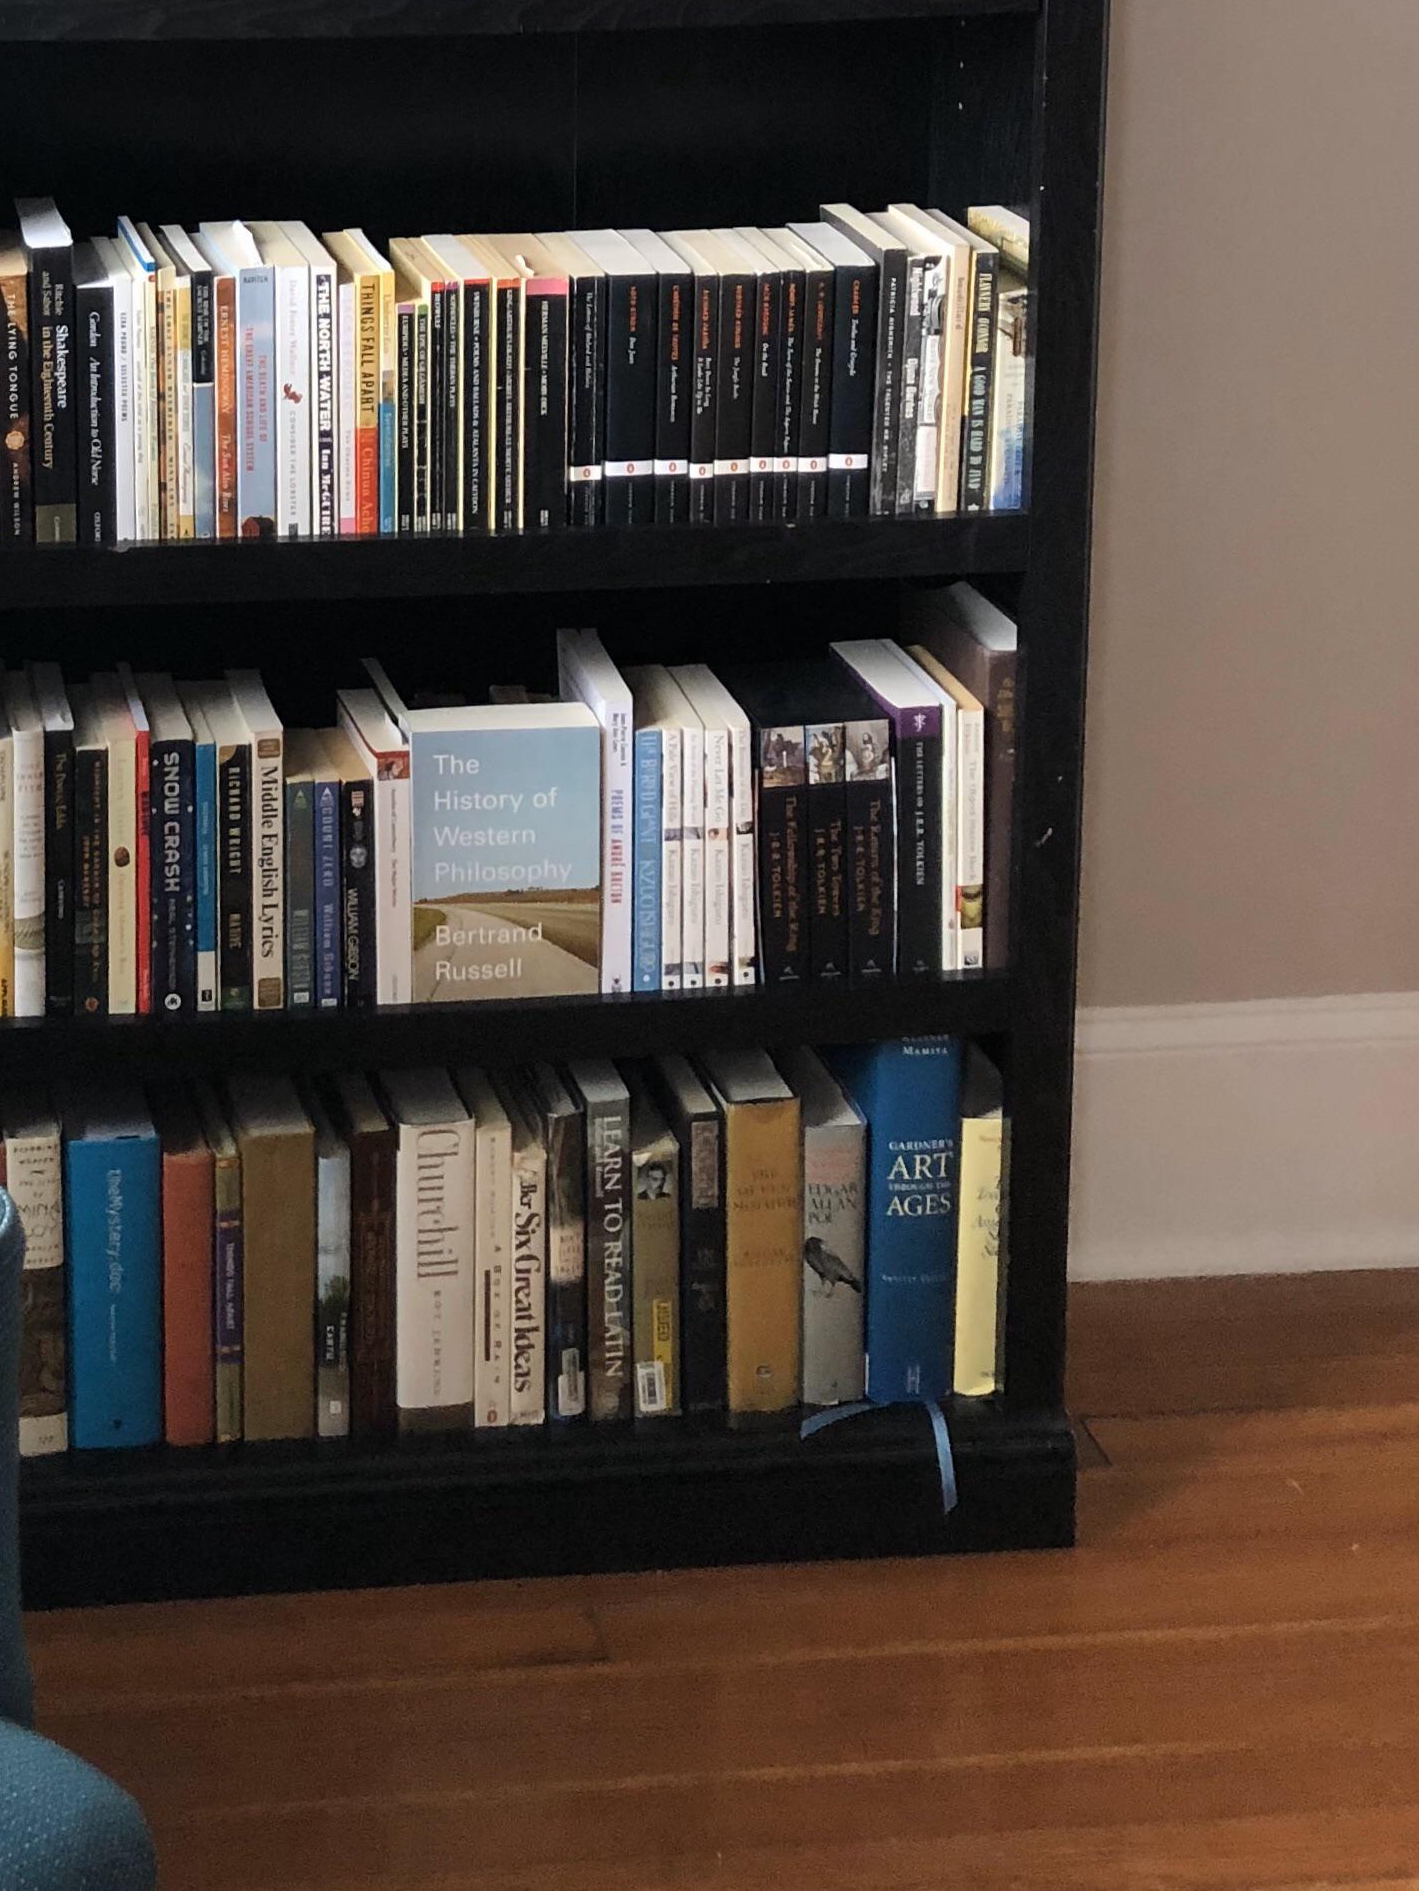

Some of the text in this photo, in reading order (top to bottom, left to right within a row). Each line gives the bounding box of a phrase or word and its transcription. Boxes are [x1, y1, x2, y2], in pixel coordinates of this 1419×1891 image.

[7, 293, 18, 419] THE LYING TONGUE
[54, 324, 69, 408] Shakespeare
[319, 283, 330, 430] THE NORTH WATER
[360, 283, 376, 413] THINGS FALL APART
[41, 326, 54, 469] in the Eighteenth Century
[362, 448, 372, 496] Chinua
[433, 754, 480, 775] The
[434, 787, 558, 813] History of
[712, 736, 725, 823] Never Let Me Go
[164, 753, 179, 892] SNOW CRASH
[261, 766, 278, 957] Middle English Lyrics
[433, 827, 535, 847] Western
[435, 859, 572, 883] Philosophy
[435, 958, 521, 980] Russell
[436, 923, 542, 946] Bertrand
[887, 1154, 954, 1180] ART
[889, 1140, 953, 1151] GARDNER'S
[414, 1131, 460, 1282] Churchill
[603, 1116, 623, 1378] LEARN TO READ LATIN
[887, 1194, 951, 1216] AGES
[514, 1212, 540, 1392] Six Great Ideas
